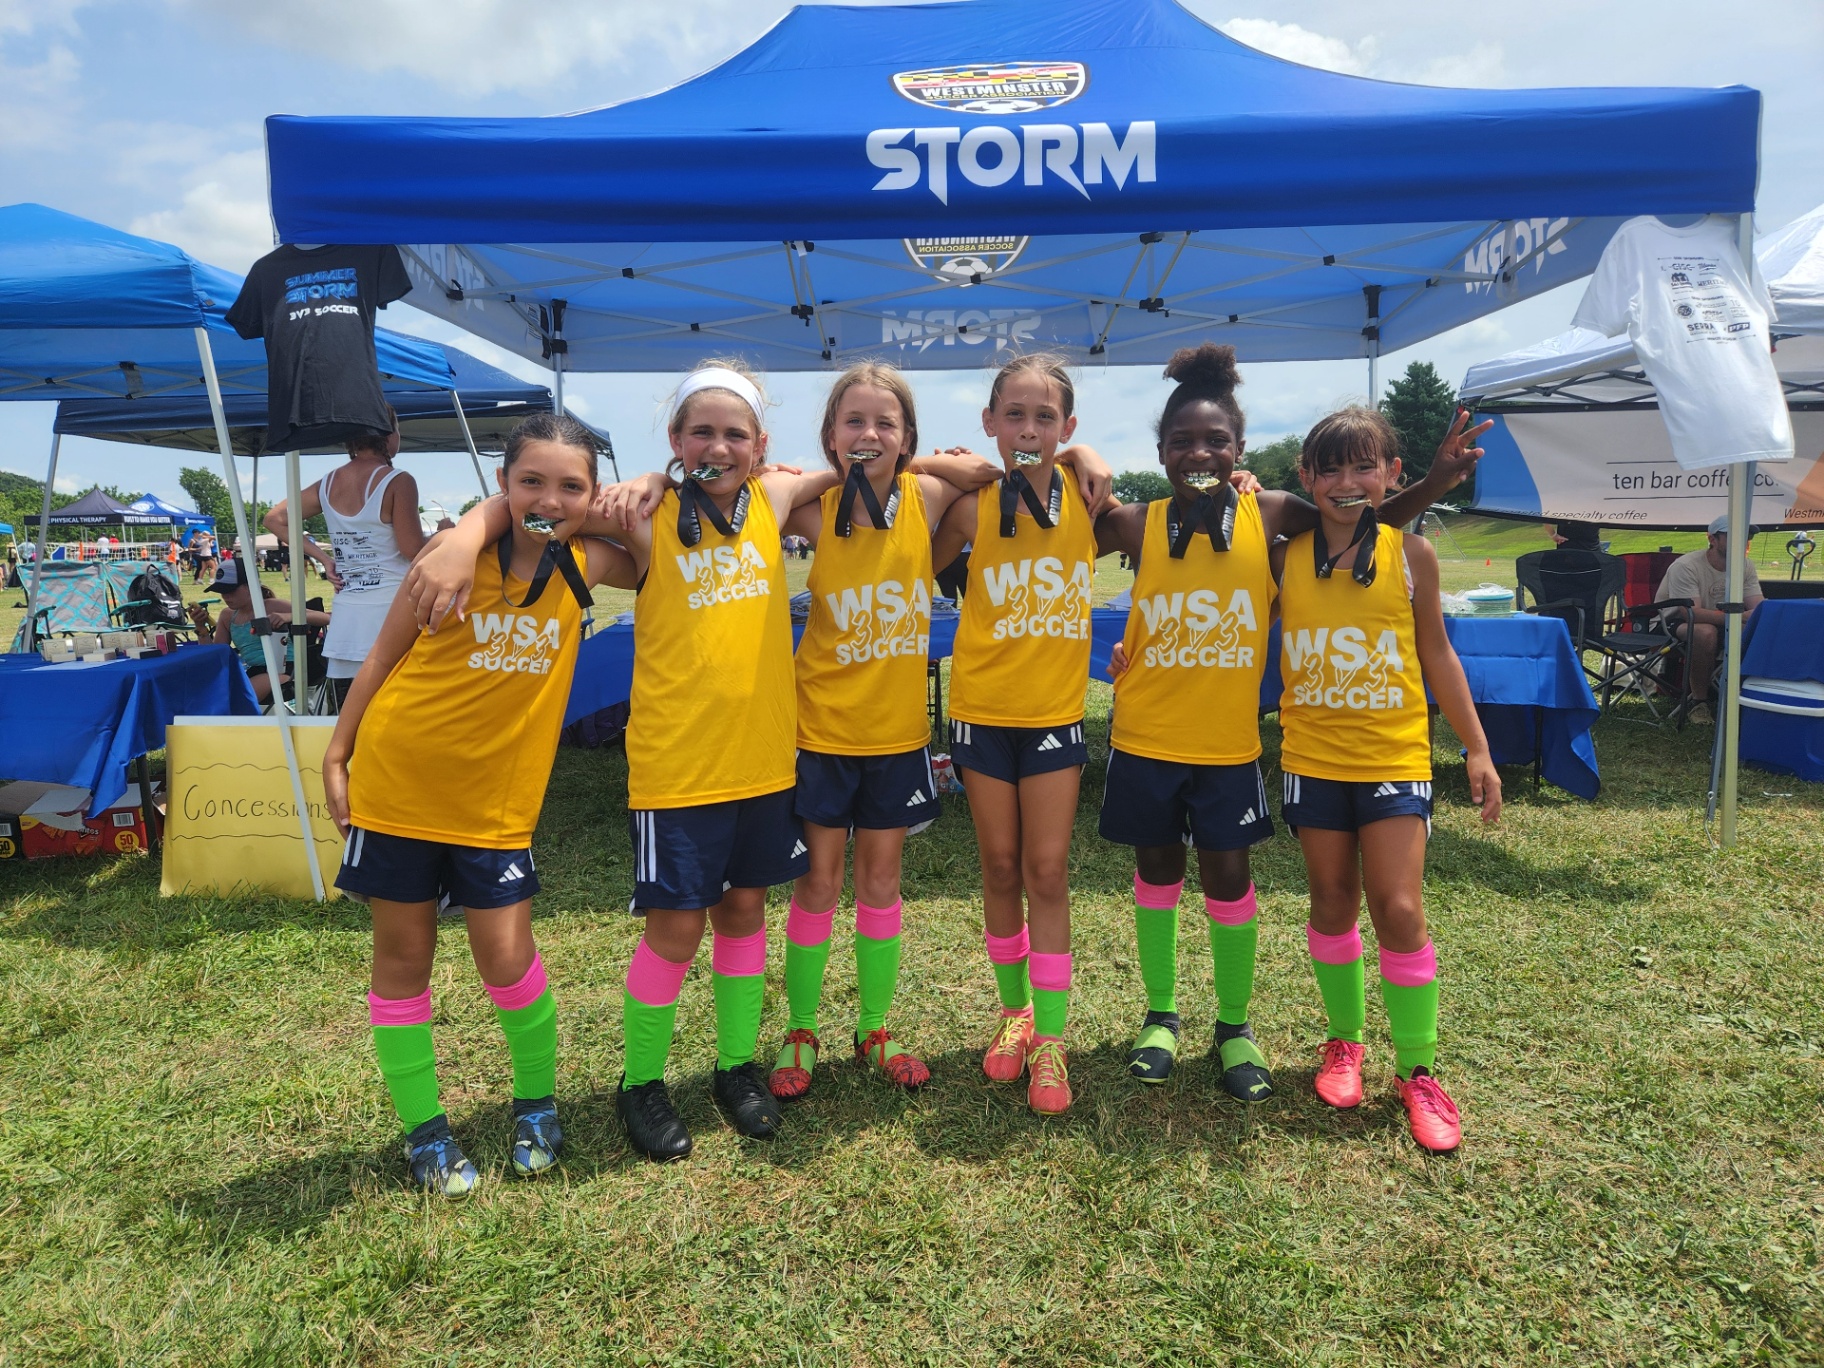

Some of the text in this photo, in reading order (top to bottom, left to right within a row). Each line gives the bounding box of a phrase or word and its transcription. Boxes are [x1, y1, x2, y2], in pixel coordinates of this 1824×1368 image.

[922, 82, 1067, 97] WESTMINSTER
[866, 121, 1156, 206] STORM
[285, 267, 358, 290] SUMMER
[285, 282, 358, 304] STORM
[314, 304, 360, 317] SOCCER
[1613, 473, 1645, 489] ten
[1651, 471, 1683, 489] bar
[1552, 511, 1607, 521] specialty
[1608, 510, 1648, 520] coffee
[675, 540, 767, 583] WSA
[983, 556, 1092, 607] WSA
[688, 579, 770, 609] SOCCER
[825, 578, 931, 631] WSA
[1138, 589, 1257, 636] WSA
[471, 613, 560, 650] WSA
[836, 634, 930, 665] SOCCER
[1144, 646, 1254, 668] SOCCER
[1284, 626, 1404, 671] WSA
[467, 652, 552, 675] SOCCER
[1293, 685, 1404, 709] SOCCER
[120, 834, 134, 846] 50
